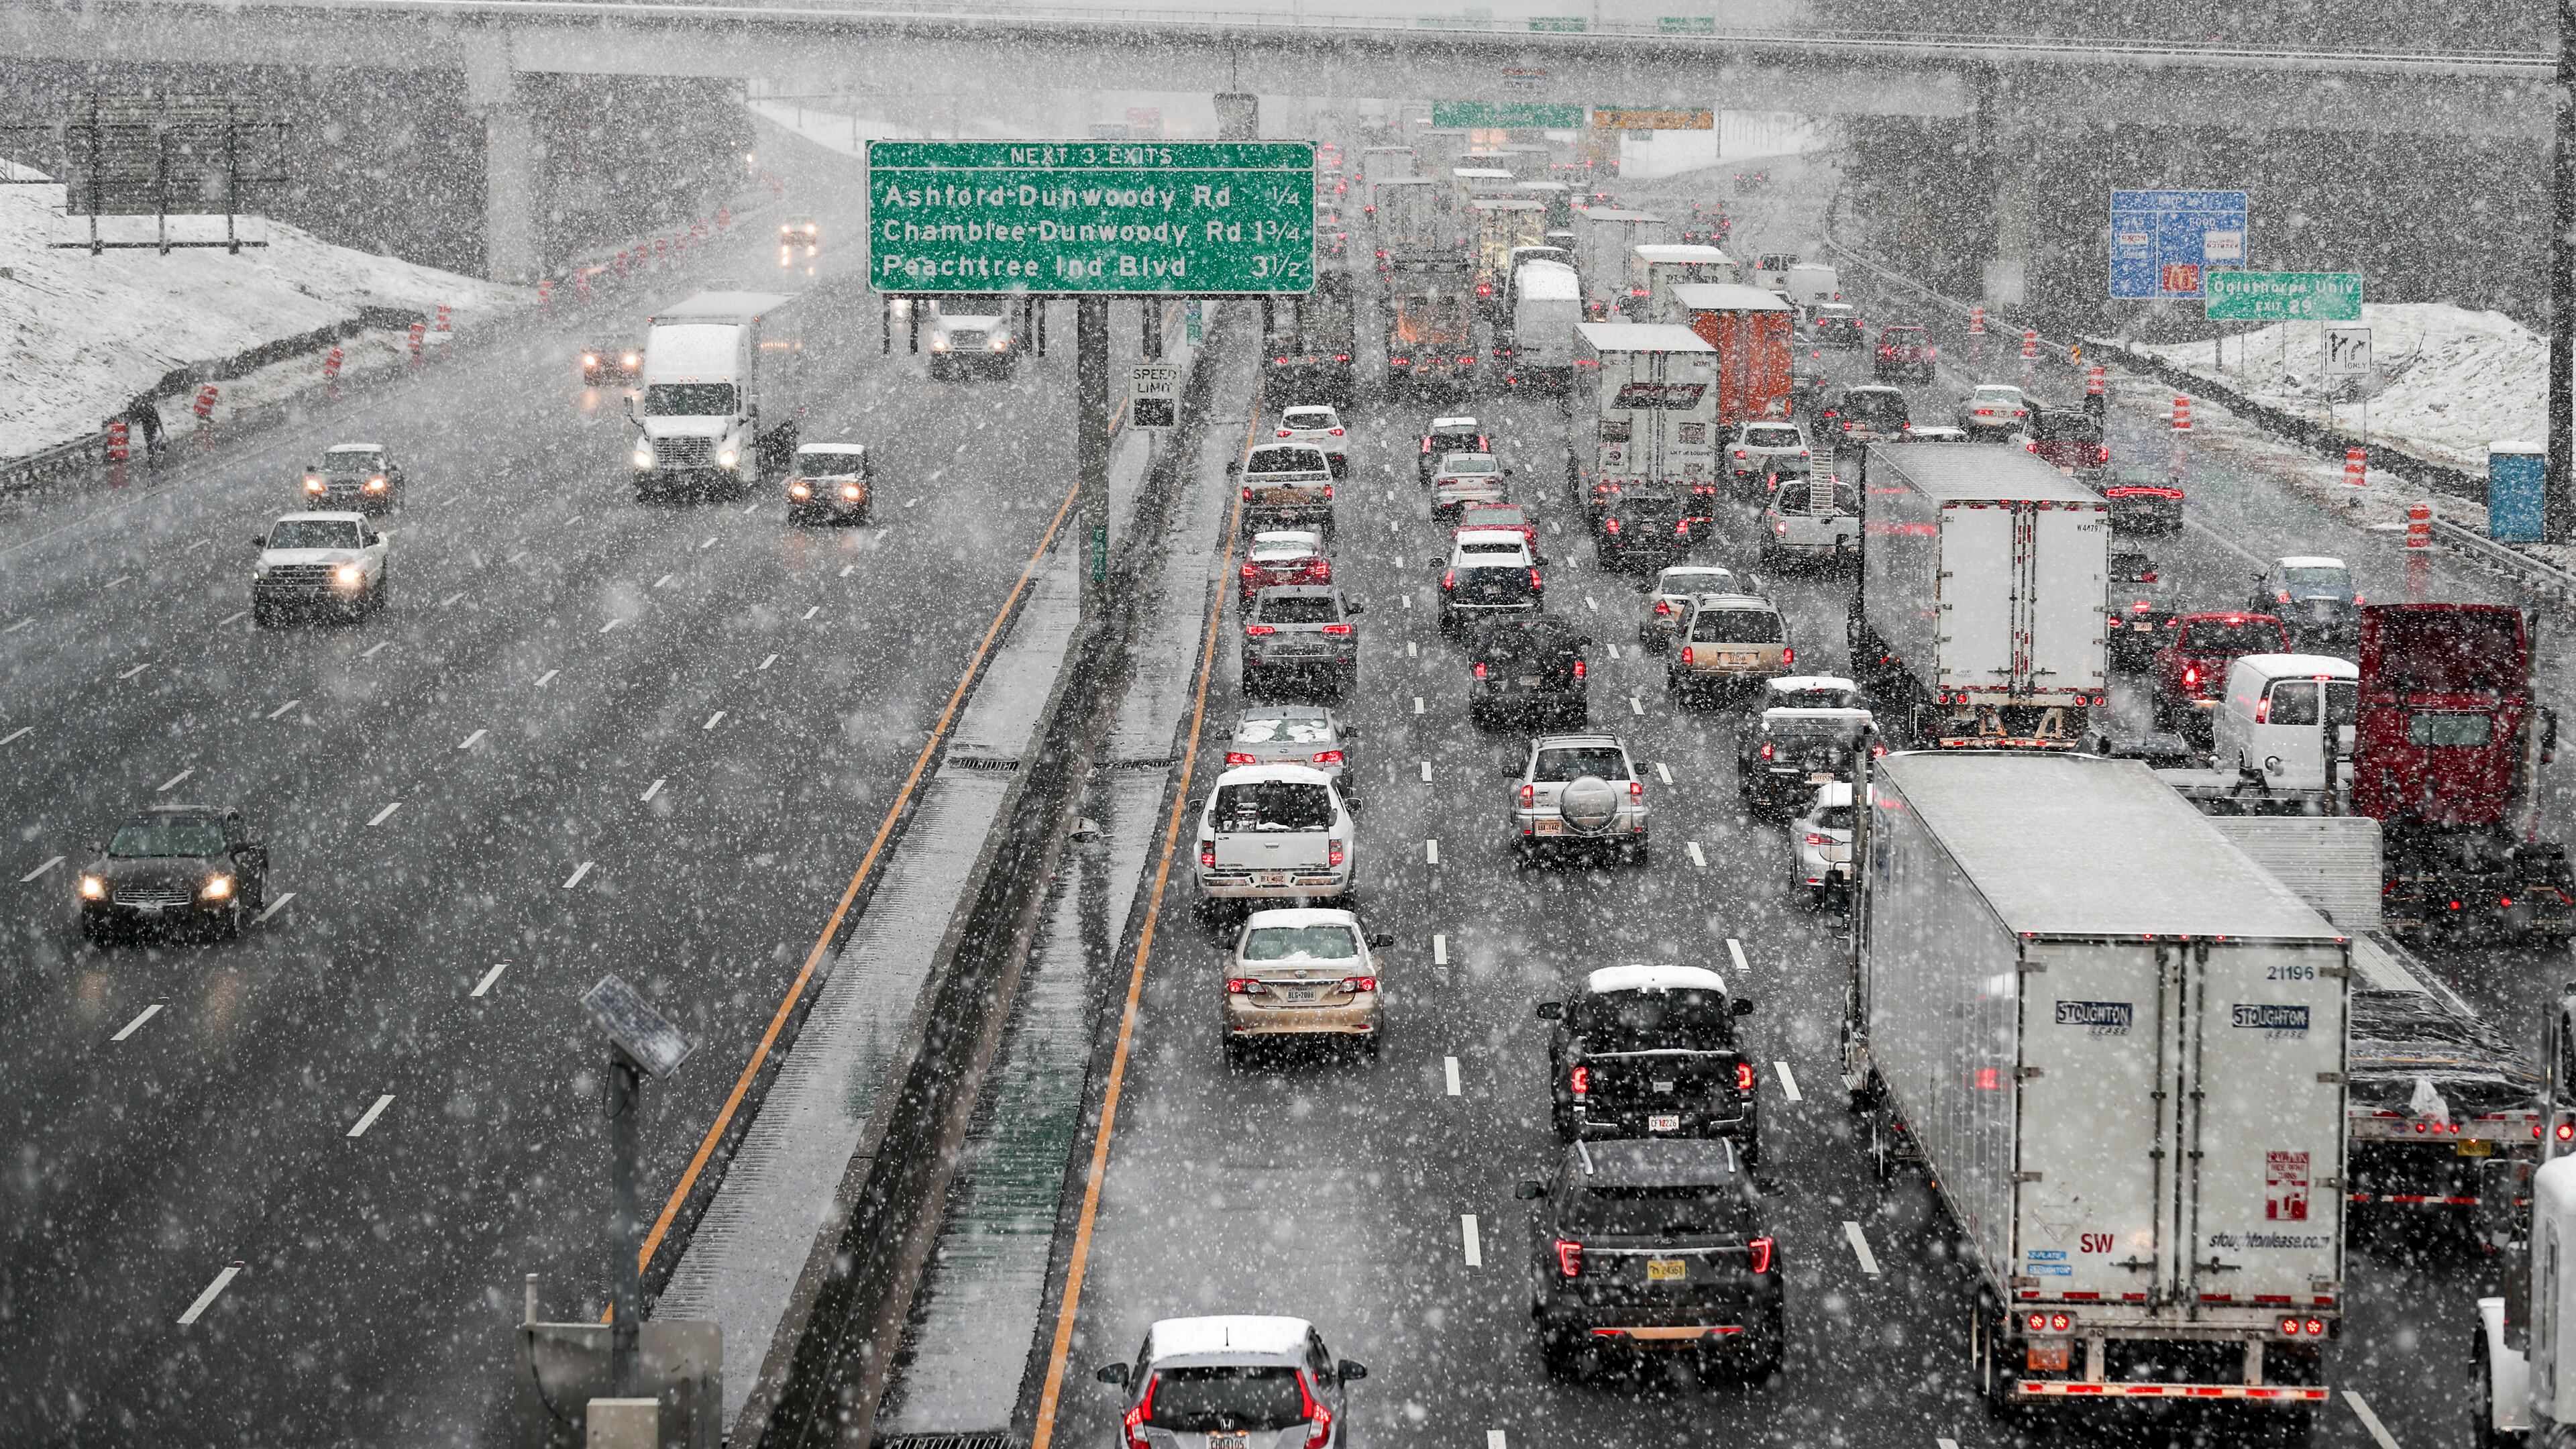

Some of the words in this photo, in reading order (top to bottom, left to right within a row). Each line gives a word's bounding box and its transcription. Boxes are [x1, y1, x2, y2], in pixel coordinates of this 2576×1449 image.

[1010, 148, 1067, 164] NEXT
[1083, 148, 1095, 164] 3
[1109, 148, 1173, 165] EXITS
[885, 184, 1177, 211] Ashford-Dunwoody
[1194, 185, 1230, 207] Rd
[2189, 217, 2216, 226] FOOD
[884, 219, 1189, 248] Chamblee-Dunwoody
[1208, 220, 1242, 241] Rd
[883, 255, 1039, 277] Peachtree
[1056, 255, 1099, 277] Ind
[1120, 255, 1185, 277] Blvd
[2214, 280, 2307, 296] Oglethorpe
[2316, 280, 2355, 294] Univ
[2256, 301, 2282, 311] EXIT
[2289, 299, 2312, 315] 29
[1132, 369, 1177, 380] SPEED
[1138, 382, 1173, 393] LIMIT
[2077, 524, 2102, 532] W44797
[2266, 965, 2314, 981] 21196
[2057, 1002, 2130, 1024] STOUGHTON
[2233, 1005, 2308, 1026] STOUGHTON
[2089, 1026, 2129, 1036] LEASE
[2265, 1029, 2306, 1039] LEASE
[2080, 1233, 2114, 1253] SW
[2209, 1231, 2330, 1252] stoughtonlease.com
